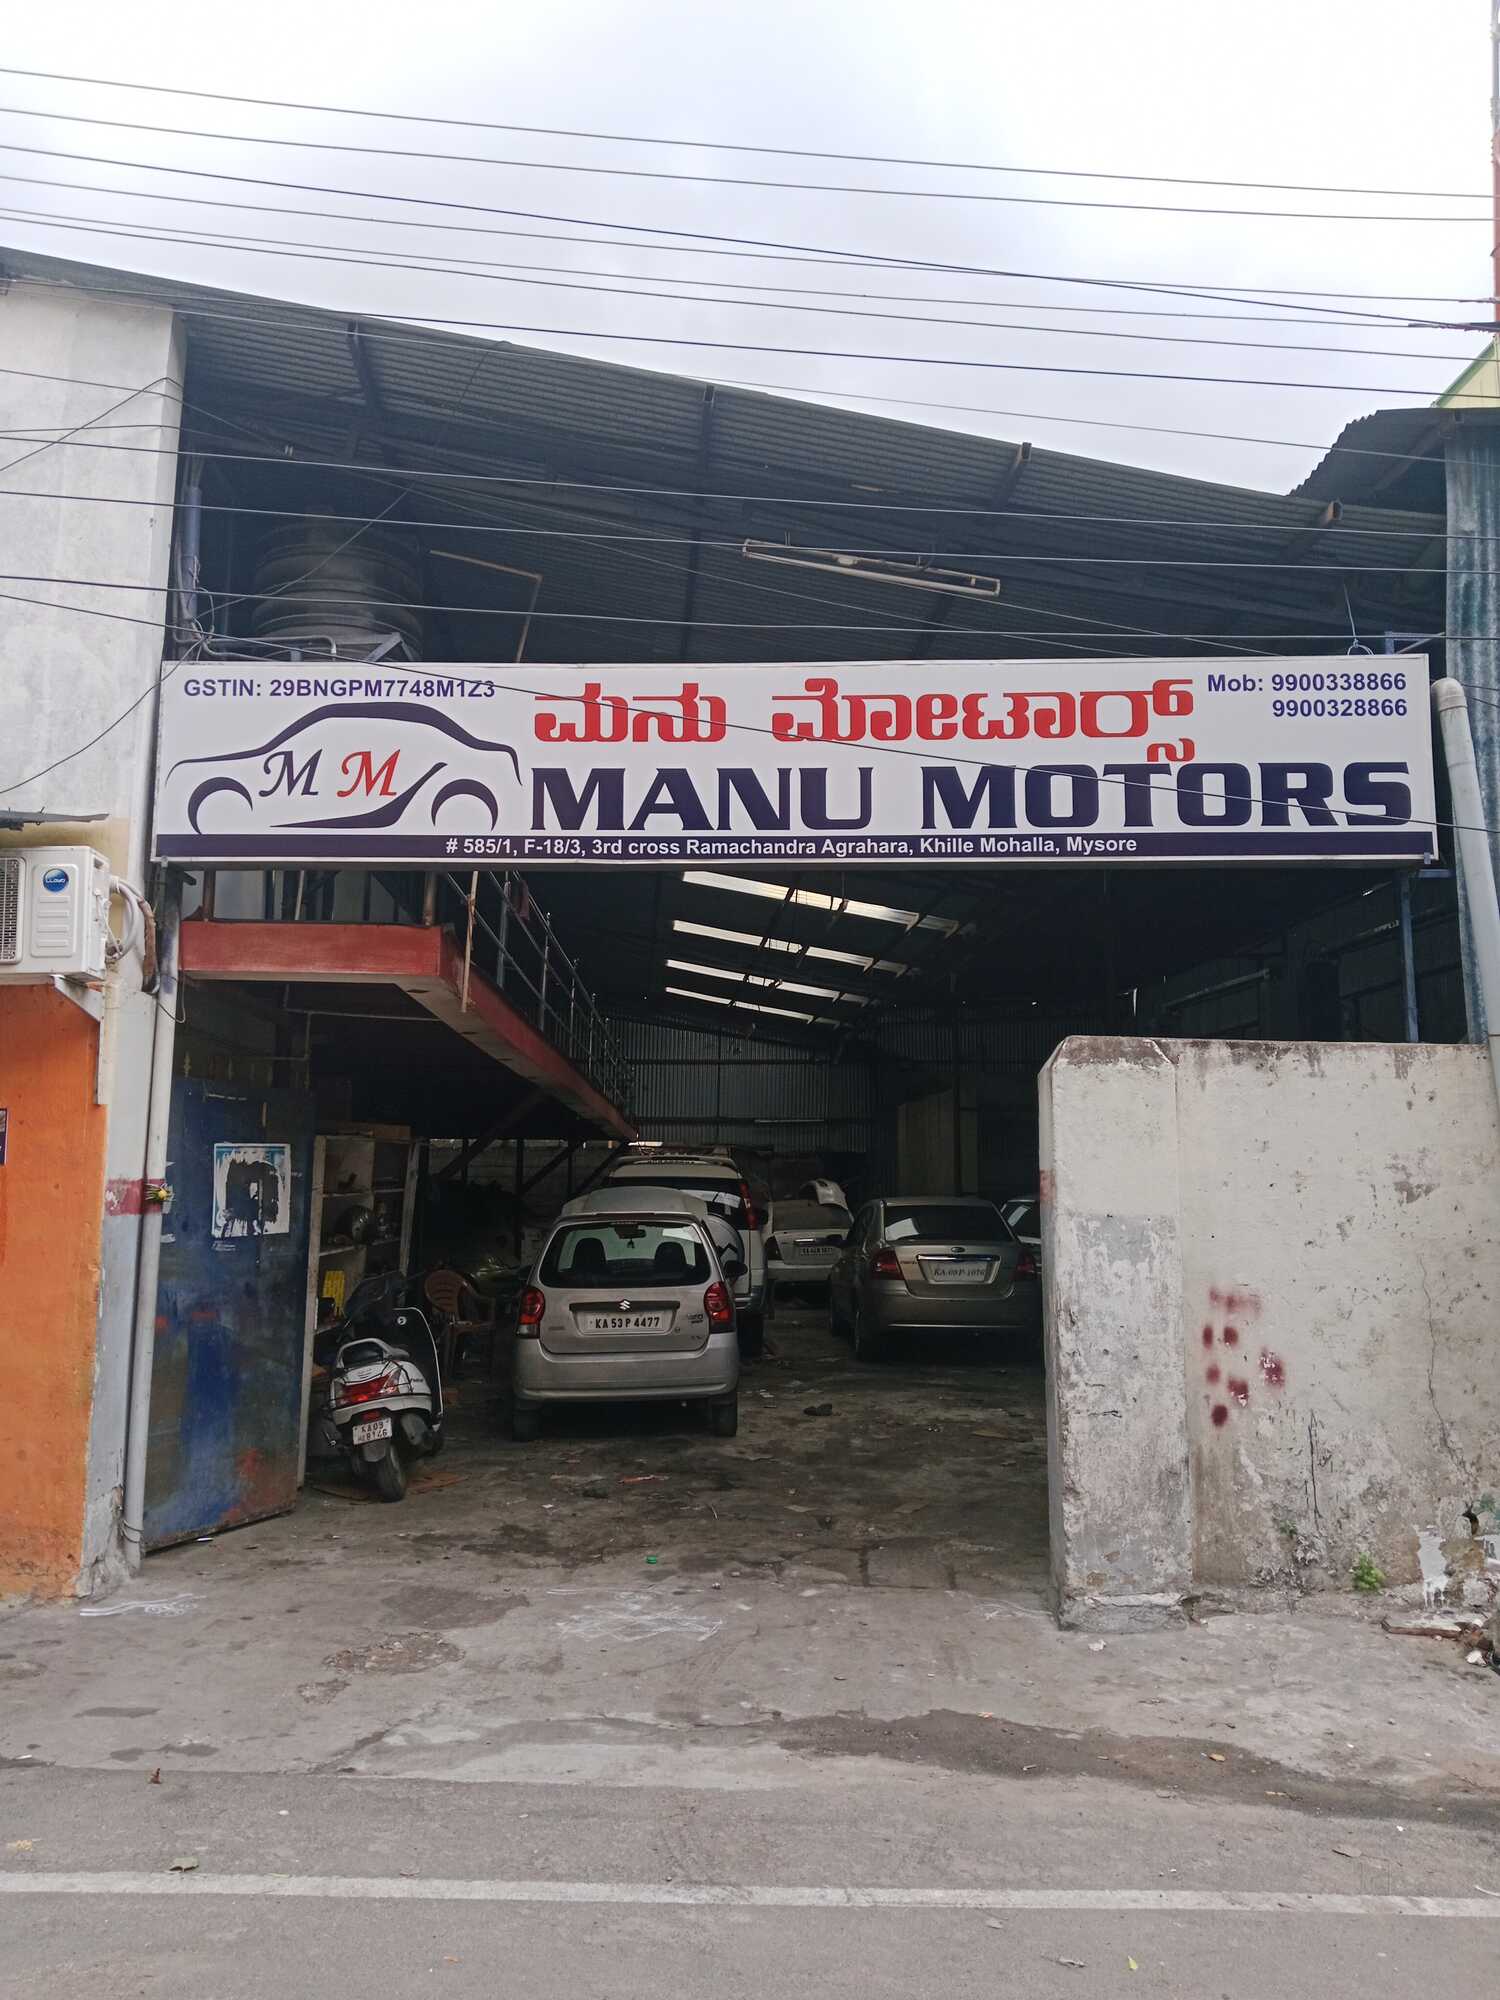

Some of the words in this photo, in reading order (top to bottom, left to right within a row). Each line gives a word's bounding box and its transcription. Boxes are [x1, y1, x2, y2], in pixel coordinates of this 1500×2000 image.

[183, 679, 262, 697] GSTIN:
[269, 678, 496, 698] 29BNGPM7748M1Z3
[1207, 674, 1264, 692] Mob:
[1271, 673, 1407, 691] 9900338866
[534, 683, 727, 742] ಮನು
[1272, 699, 1408, 717] 9900328866
[530, 767, 872, 830] MANU
[920, 761, 1413, 829] MOTORS
[463, 838, 518, 856] 585/1,
[524, 838, 586, 856] F-18/3,
[592, 839, 622, 854] 3rd
[628, 842, 680, 854] cross
[686, 838, 816, 854] Ramachandra
[821, 838, 914, 856] Agrahara,
[920, 838, 974, 853] Khille
[980, 837, 1060, 854] Mohalla,
[1066, 836, 1137, 855] Mysore
[595, 1318, 609, 1329] KA
[611, 1318, 623, 1328] 53
[633, 1317, 660, 1328] 4477
